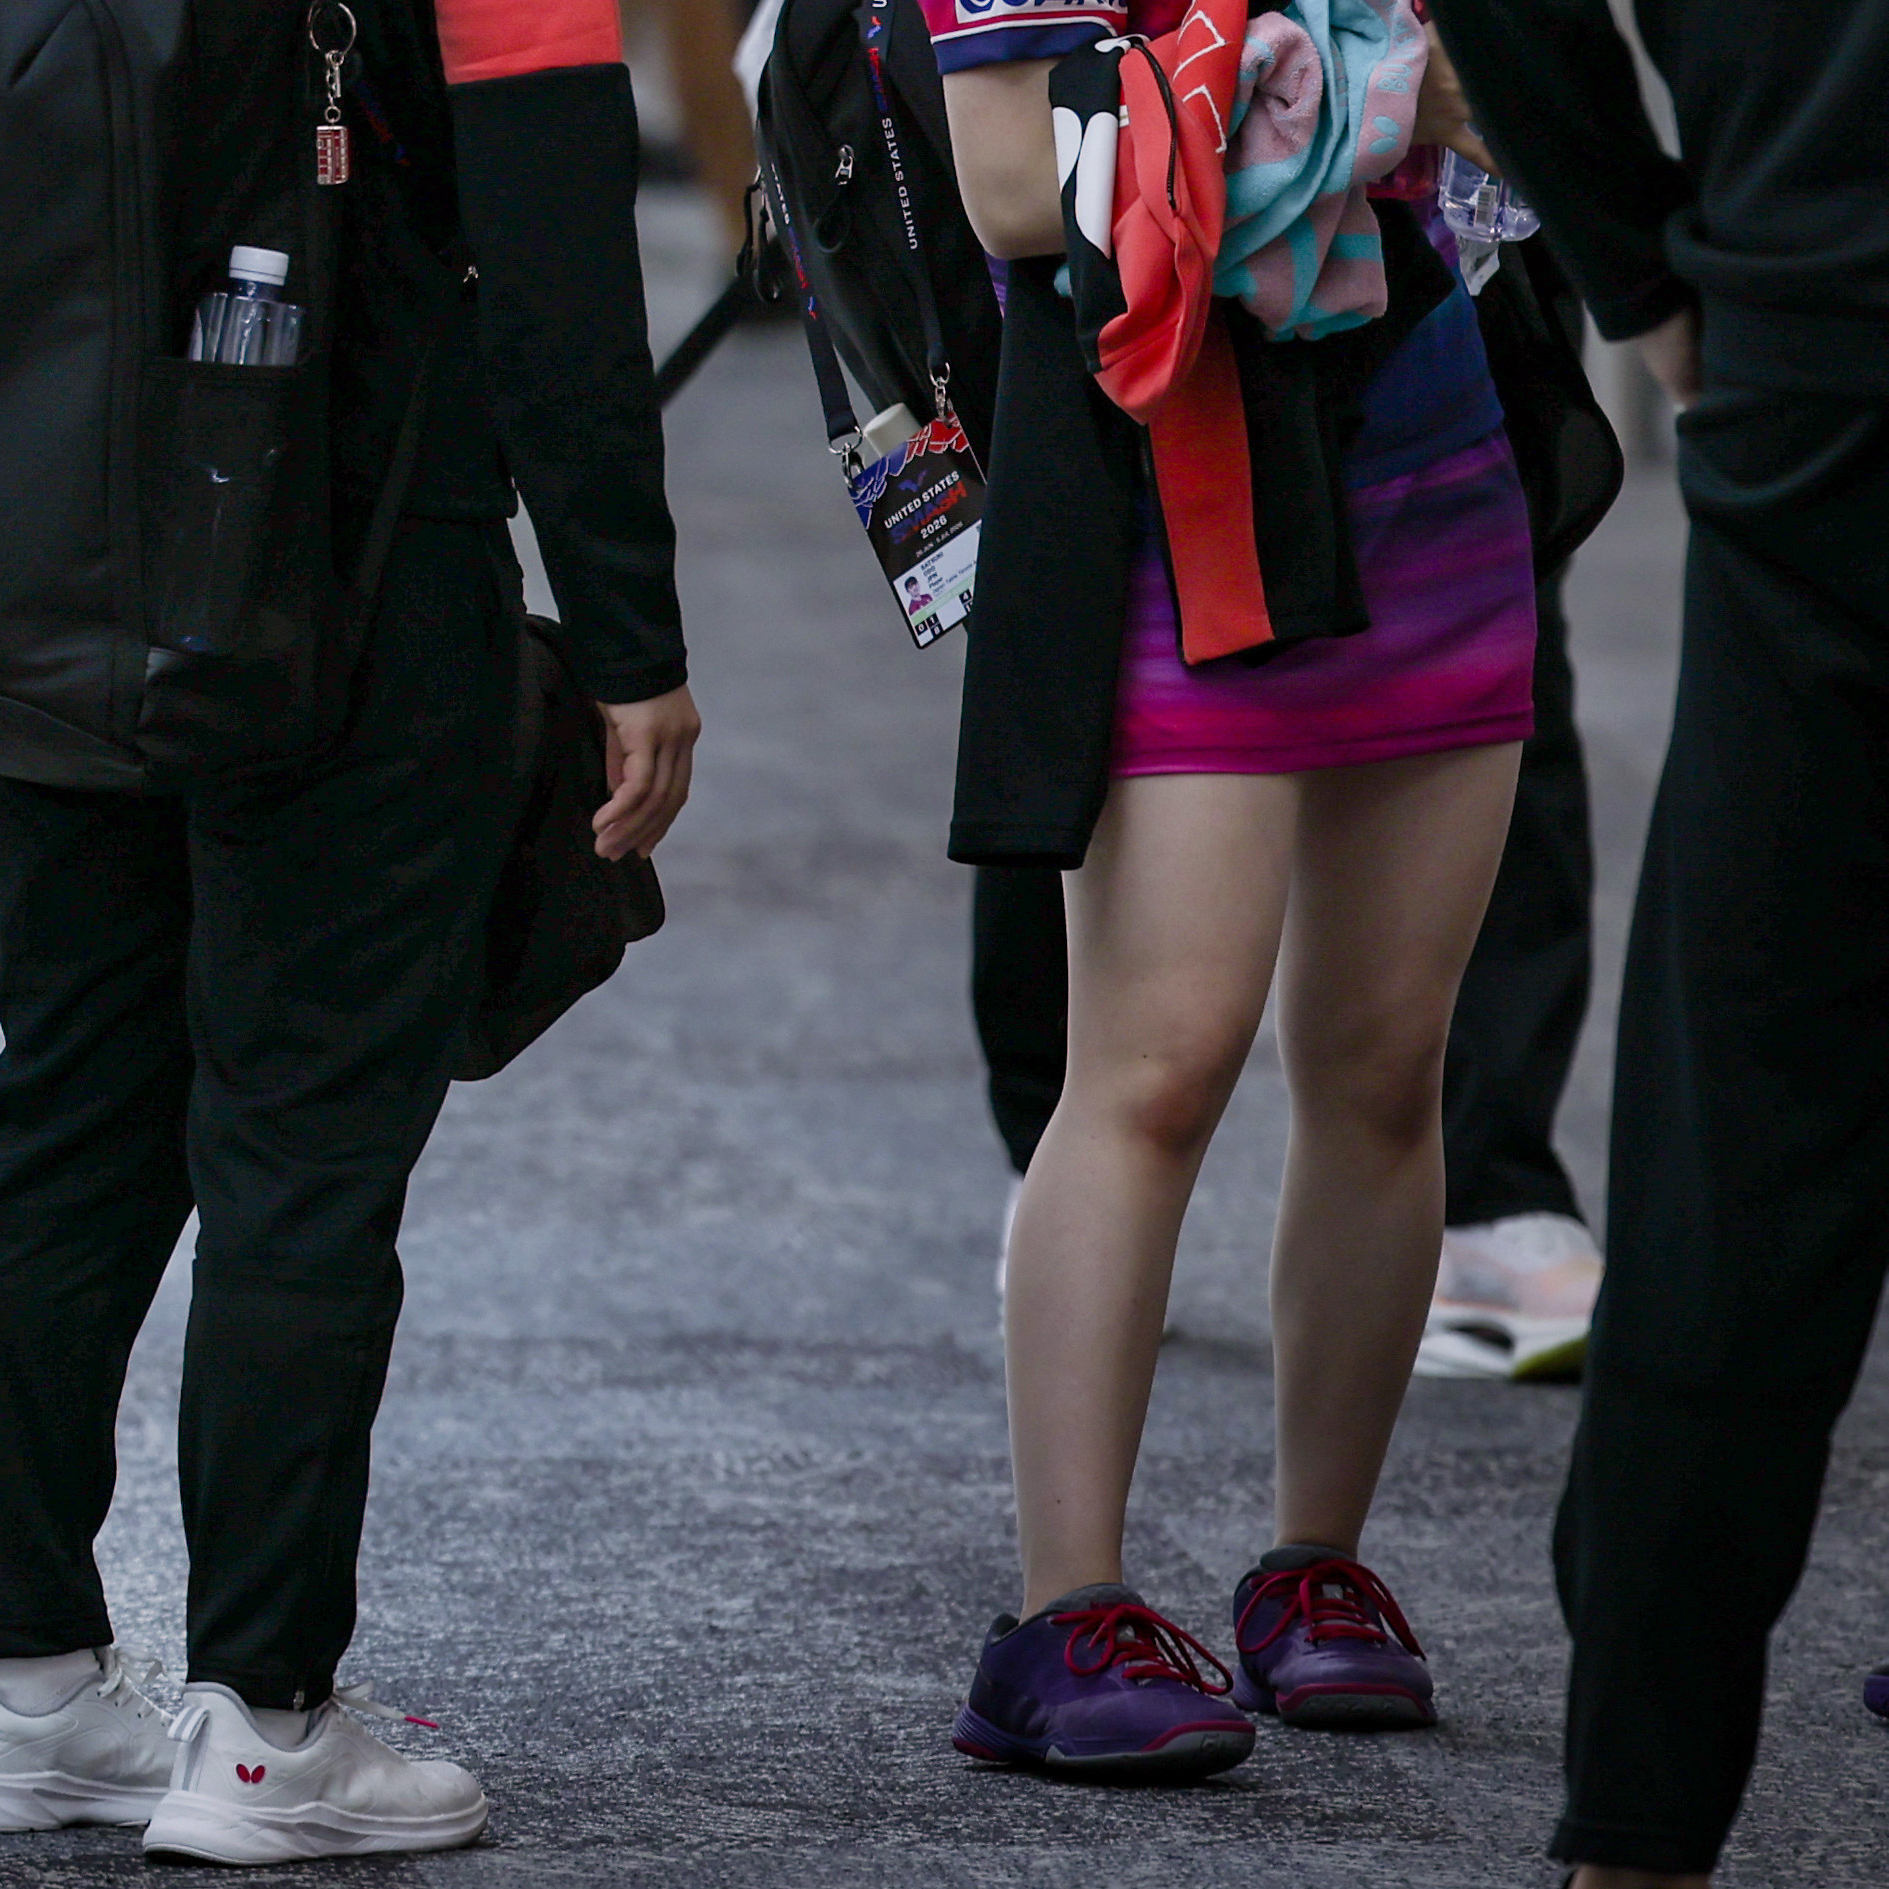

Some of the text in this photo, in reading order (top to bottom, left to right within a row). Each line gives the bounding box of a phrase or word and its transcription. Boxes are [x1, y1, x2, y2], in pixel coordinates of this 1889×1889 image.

[881, 117, 919, 250] UNITED STATES
[883, 470, 960, 530] UNITED STATES
[920, 515, 948, 539] 2026
